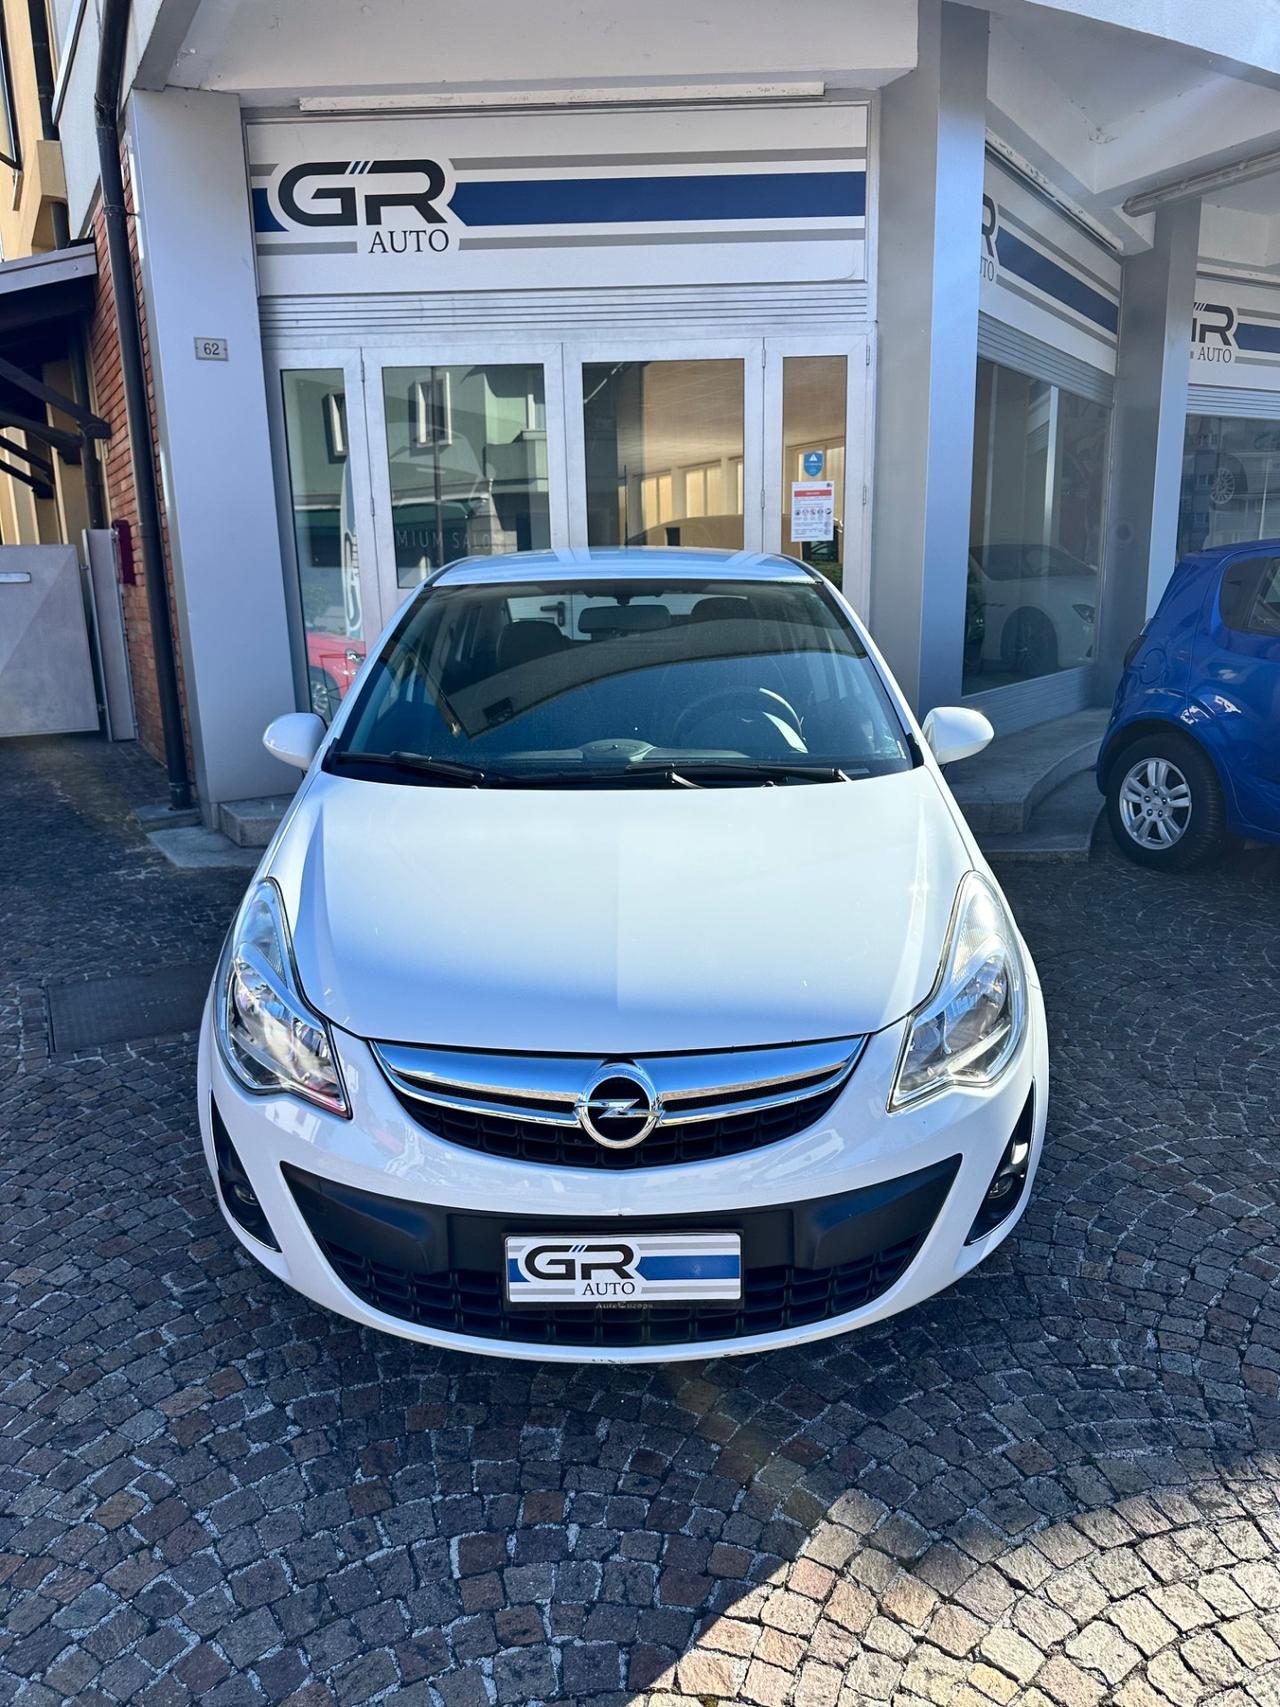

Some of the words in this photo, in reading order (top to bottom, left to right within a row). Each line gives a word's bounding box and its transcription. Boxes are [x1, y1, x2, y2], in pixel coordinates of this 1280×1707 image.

[278, 159, 447, 227] GR
[368, 229, 449, 254] AUTO
[203, 342, 220, 356] 62
[1197, 346, 1232, 363] AUTO
[525, 1244, 635, 1280] GR
[582, 1281, 636, 1296] AUTO
